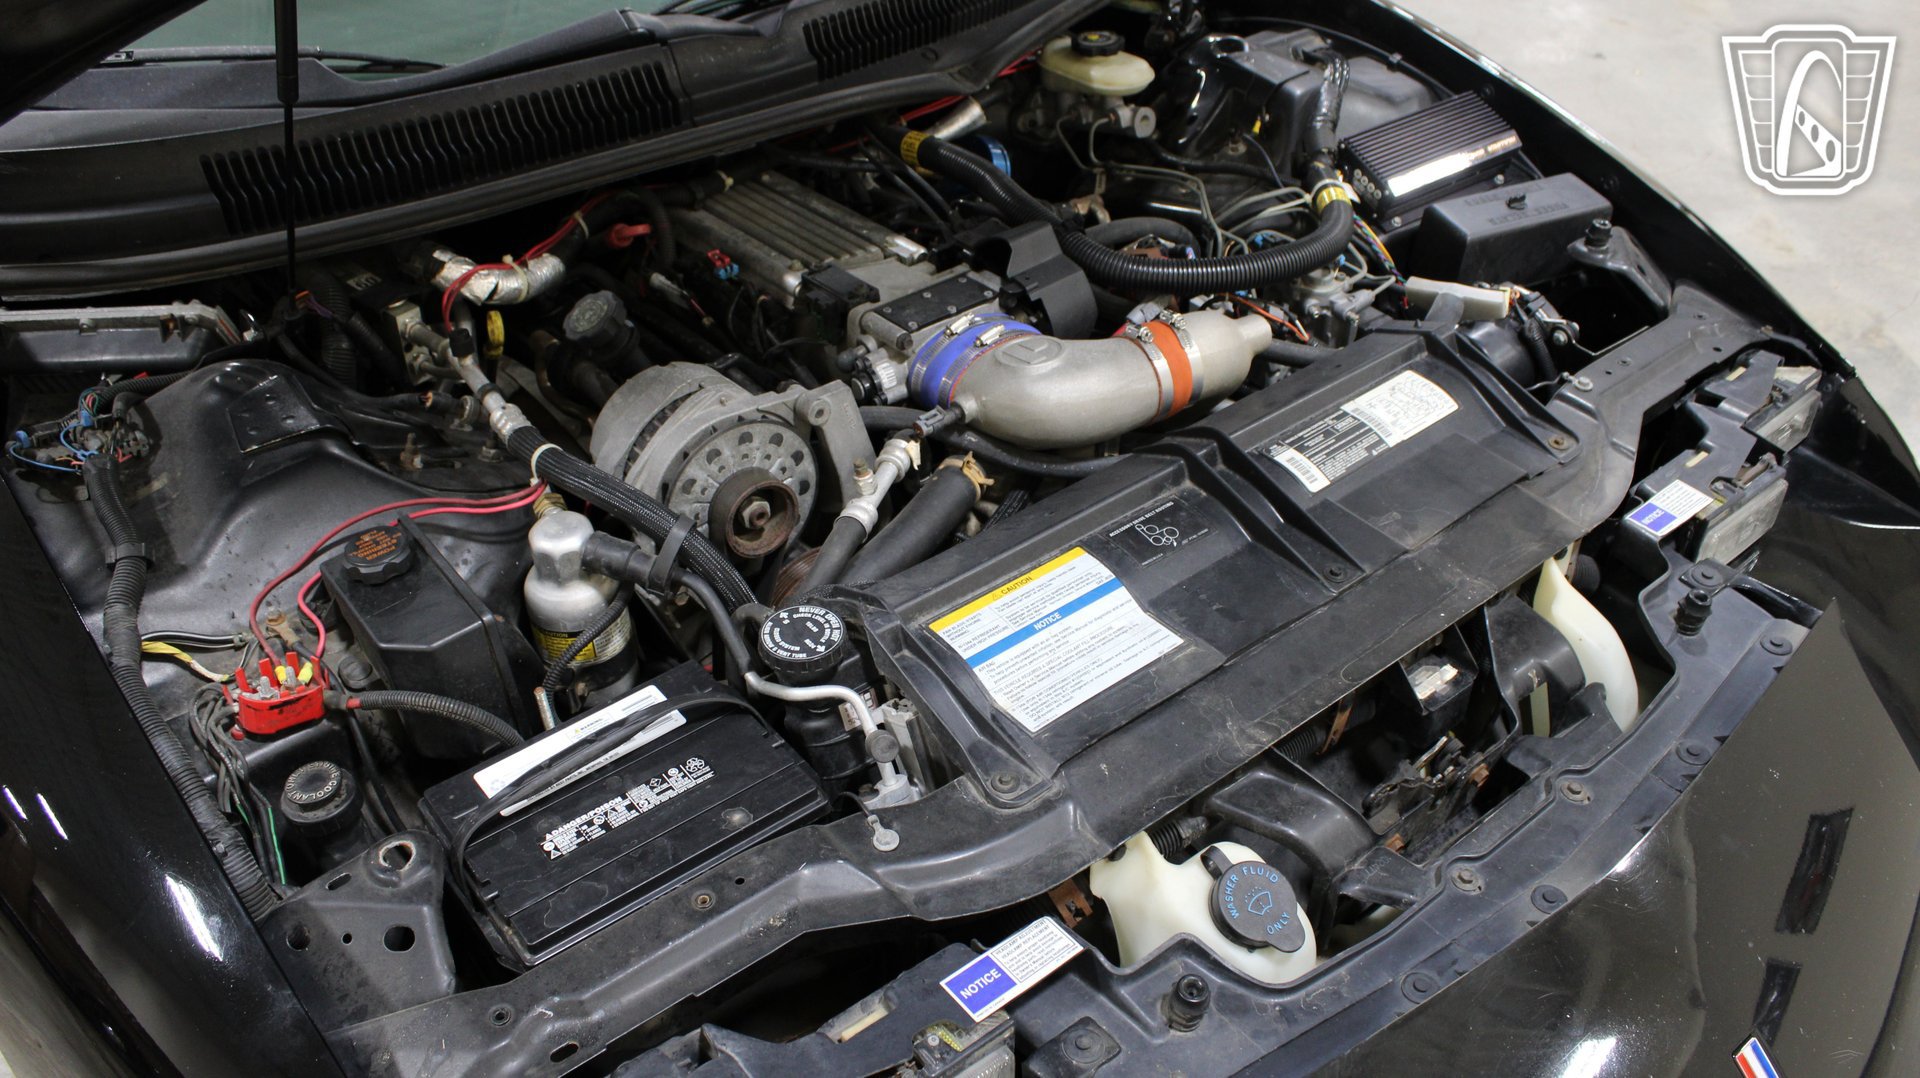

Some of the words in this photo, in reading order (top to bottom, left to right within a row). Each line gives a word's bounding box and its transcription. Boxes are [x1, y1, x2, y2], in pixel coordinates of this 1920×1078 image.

[1001, 576, 1032, 596] CAUTION
[798, 606, 826, 616] NEVER
[812, 614, 826, 624] LEVEL
[824, 612, 840, 628] OPEN
[1033, 612, 1062, 631] NOTICE
[830, 628, 840, 642] HOT
[287, 780, 337, 802] COOLANT
[550, 796, 622, 836] DANGER/POISON
[1225, 874, 1240, 919] WASHER
[1242, 866, 1279, 884] FLUID
[1267, 912, 1290, 935] ONLY
[960, 968, 1002, 1000] NOTICE
